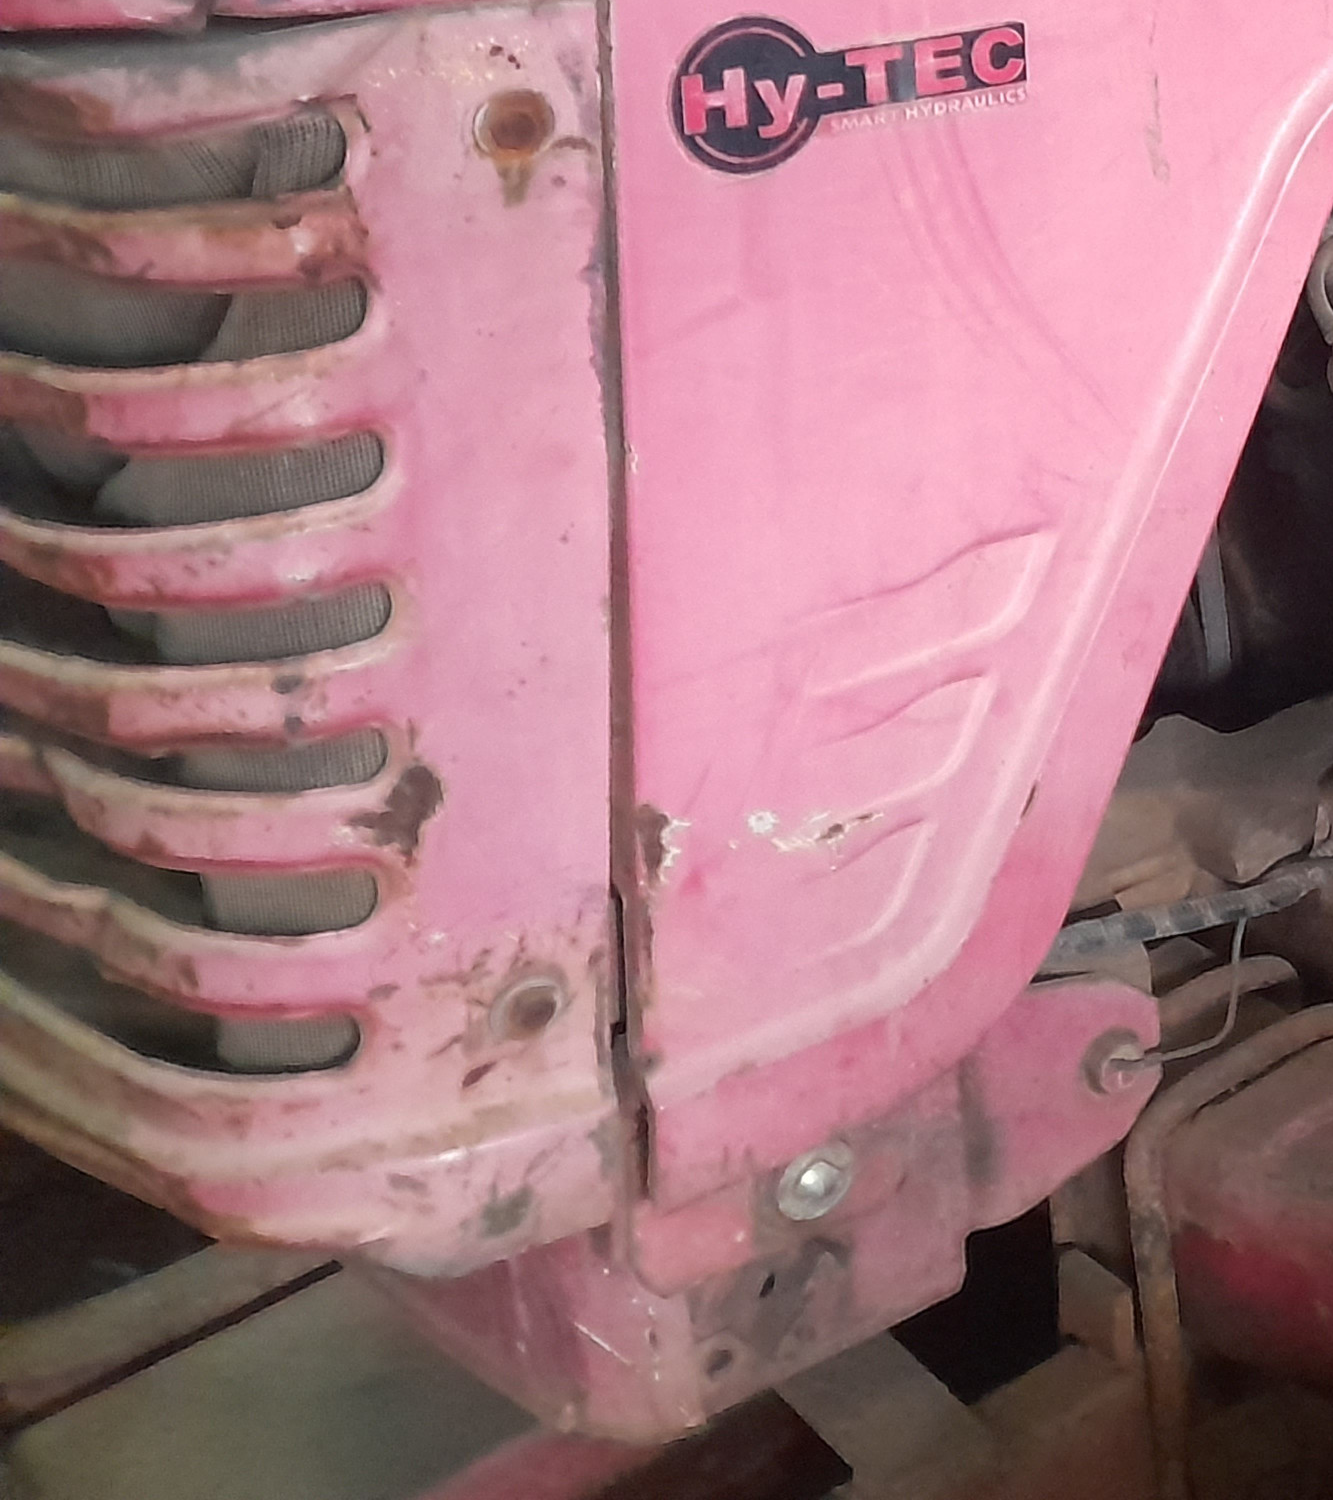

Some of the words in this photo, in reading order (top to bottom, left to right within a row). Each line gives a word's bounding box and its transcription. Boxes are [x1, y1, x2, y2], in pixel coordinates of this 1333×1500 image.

[681, 26, 1025, 139] Hy-TEC
[831, 112, 898, 133] SMART
[904, 87, 1027, 121] HYDRAULICS
